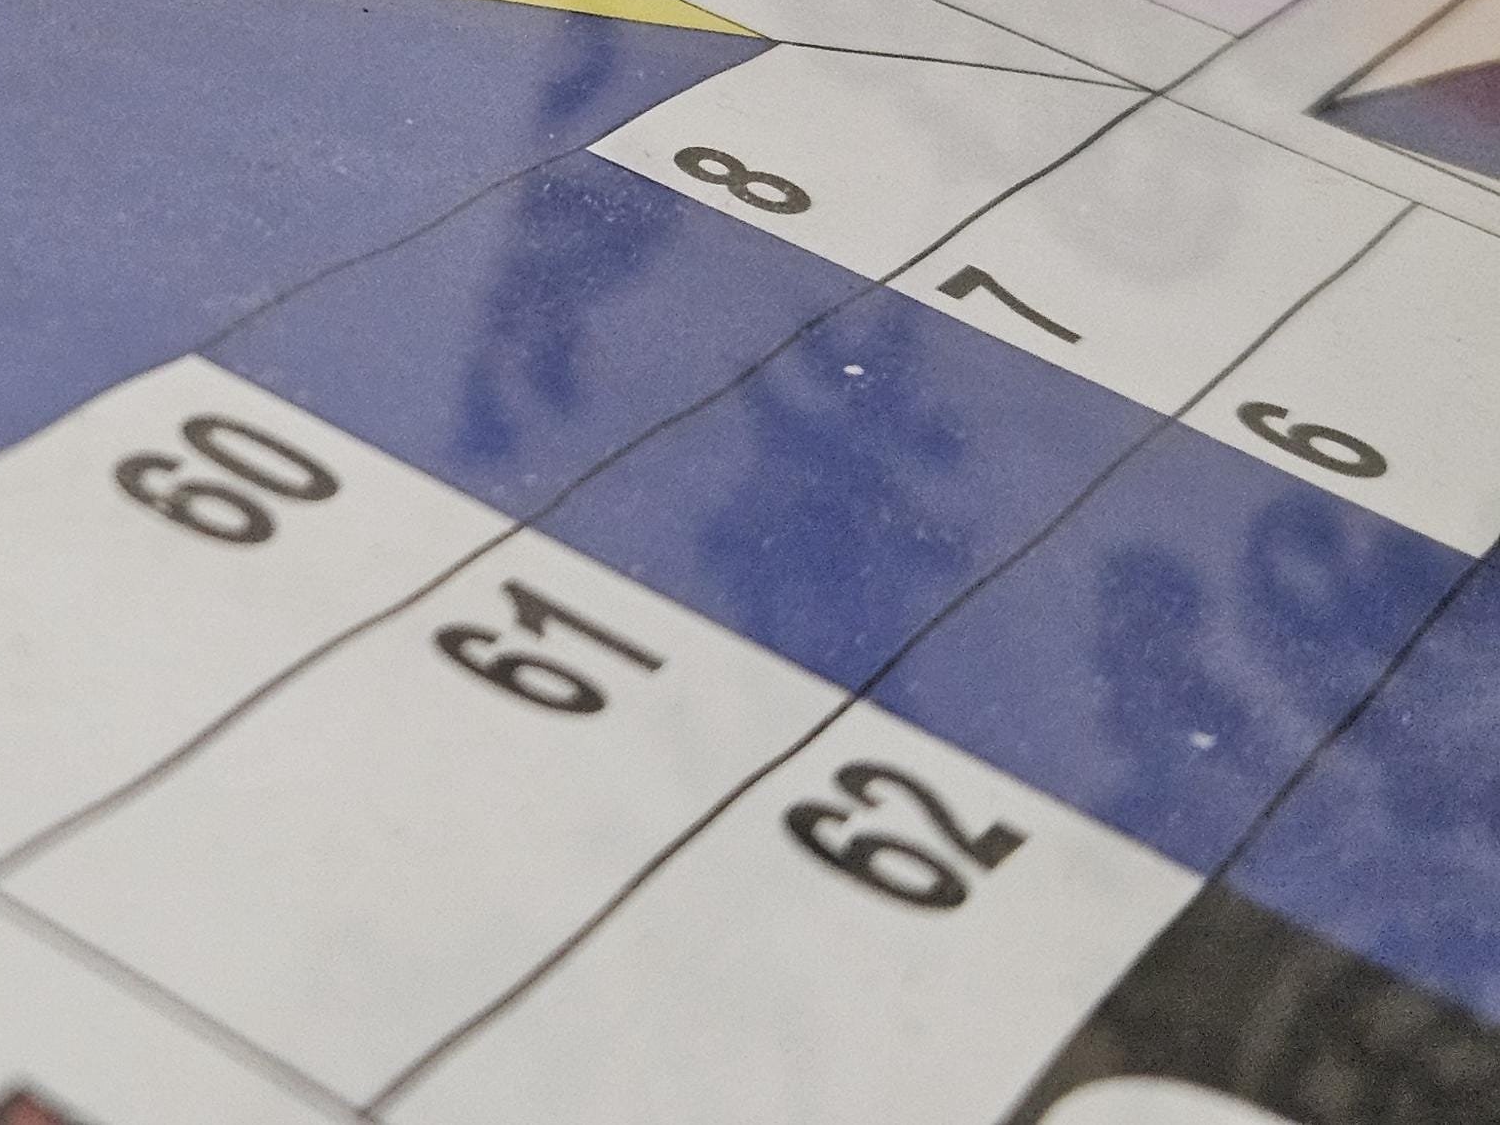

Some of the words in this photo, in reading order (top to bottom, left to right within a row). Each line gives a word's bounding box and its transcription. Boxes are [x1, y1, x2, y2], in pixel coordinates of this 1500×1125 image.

[674, 145, 812, 215] 8
[936, 264, 1082, 344] 7
[113, 413, 342, 546] 60
[1236, 400, 1387, 478] 6
[433, 577, 665, 716] 61
[782, 758, 1030, 911] 62
